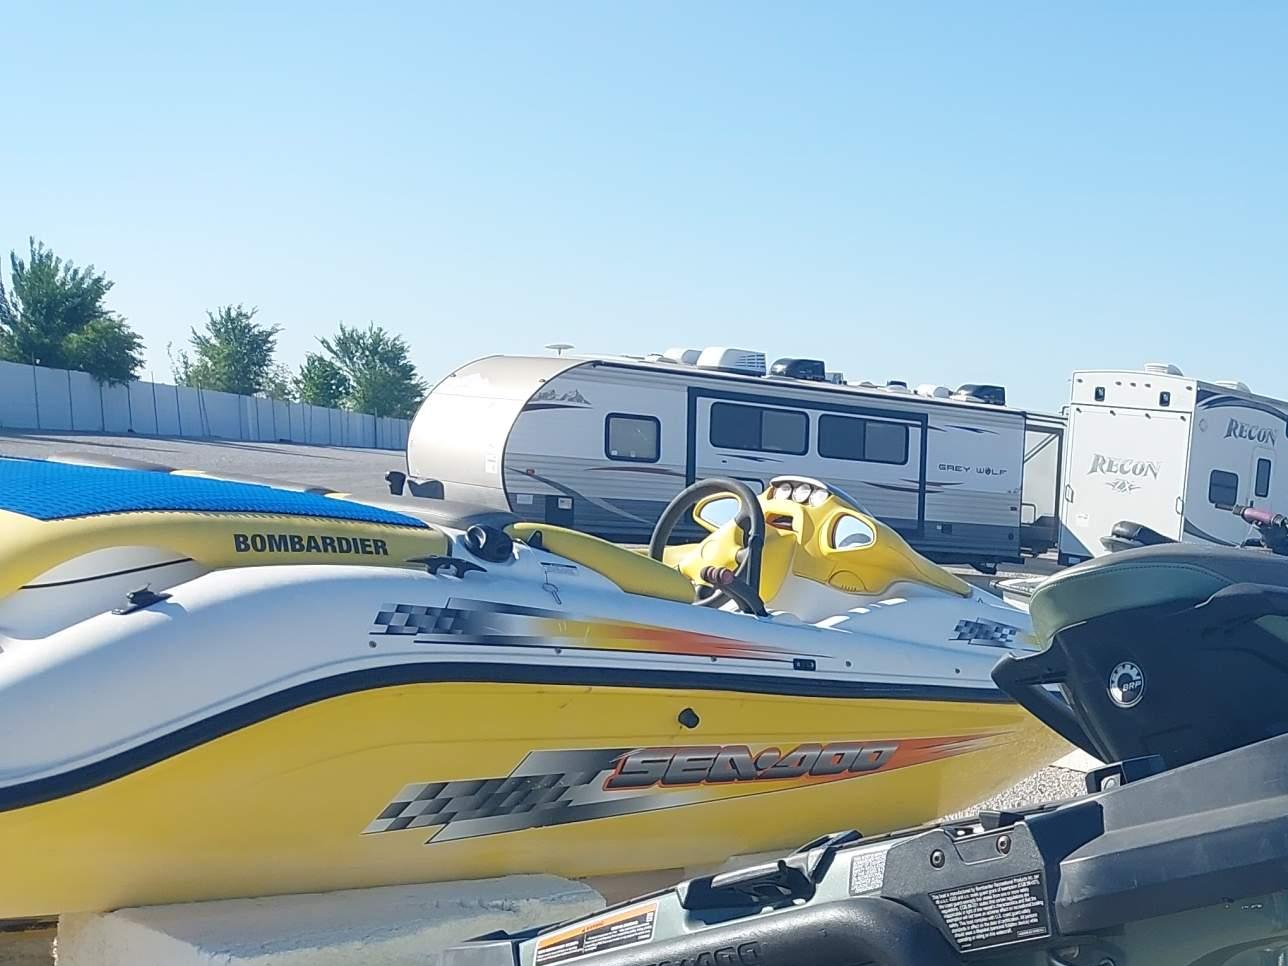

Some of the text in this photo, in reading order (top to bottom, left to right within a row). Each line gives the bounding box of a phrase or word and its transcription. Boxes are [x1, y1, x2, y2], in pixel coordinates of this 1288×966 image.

[1224, 418, 1277, 447] RECON
[938, 463, 971, 472] GREY
[1088, 453, 1160, 480] RECON
[233, 533, 389, 556] BOMBARDIER
[1122, 680, 1142, 691] BRP
